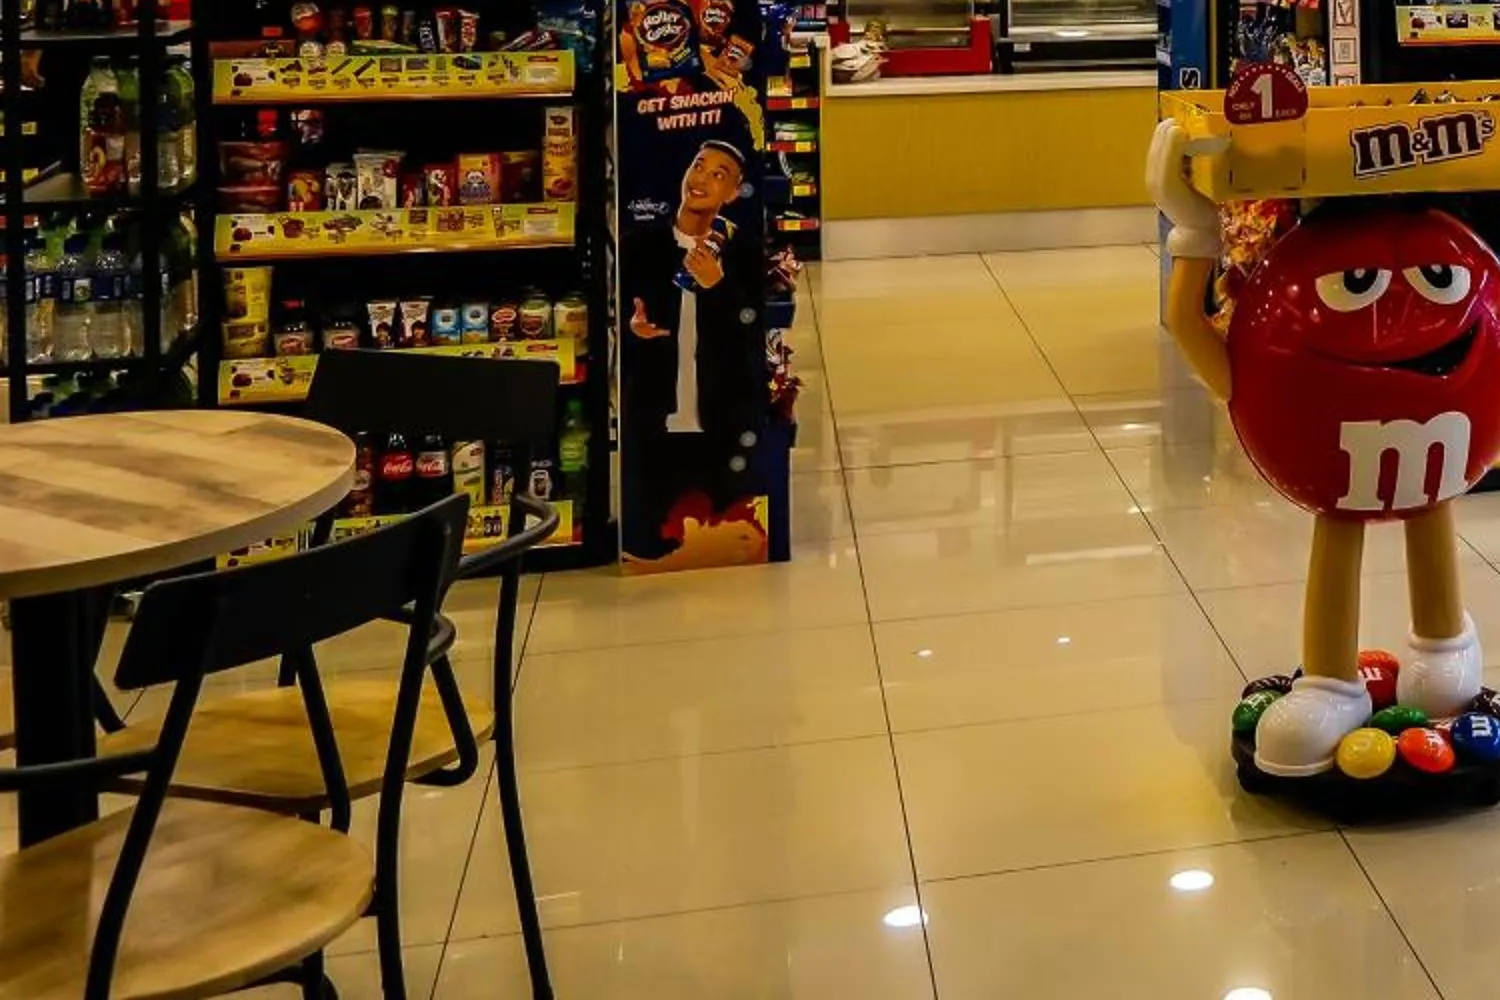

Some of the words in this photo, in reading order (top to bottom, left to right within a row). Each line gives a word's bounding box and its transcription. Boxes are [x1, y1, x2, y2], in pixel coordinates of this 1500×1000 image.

[637, 96, 667, 114] GET
[669, 87, 738, 110] SNACKIN'
[1249, 72, 1273, 119] 1
[657, 112, 697, 131] WITH
[700, 108, 721, 125] IT!
[1335, 410, 1471, 511] m
